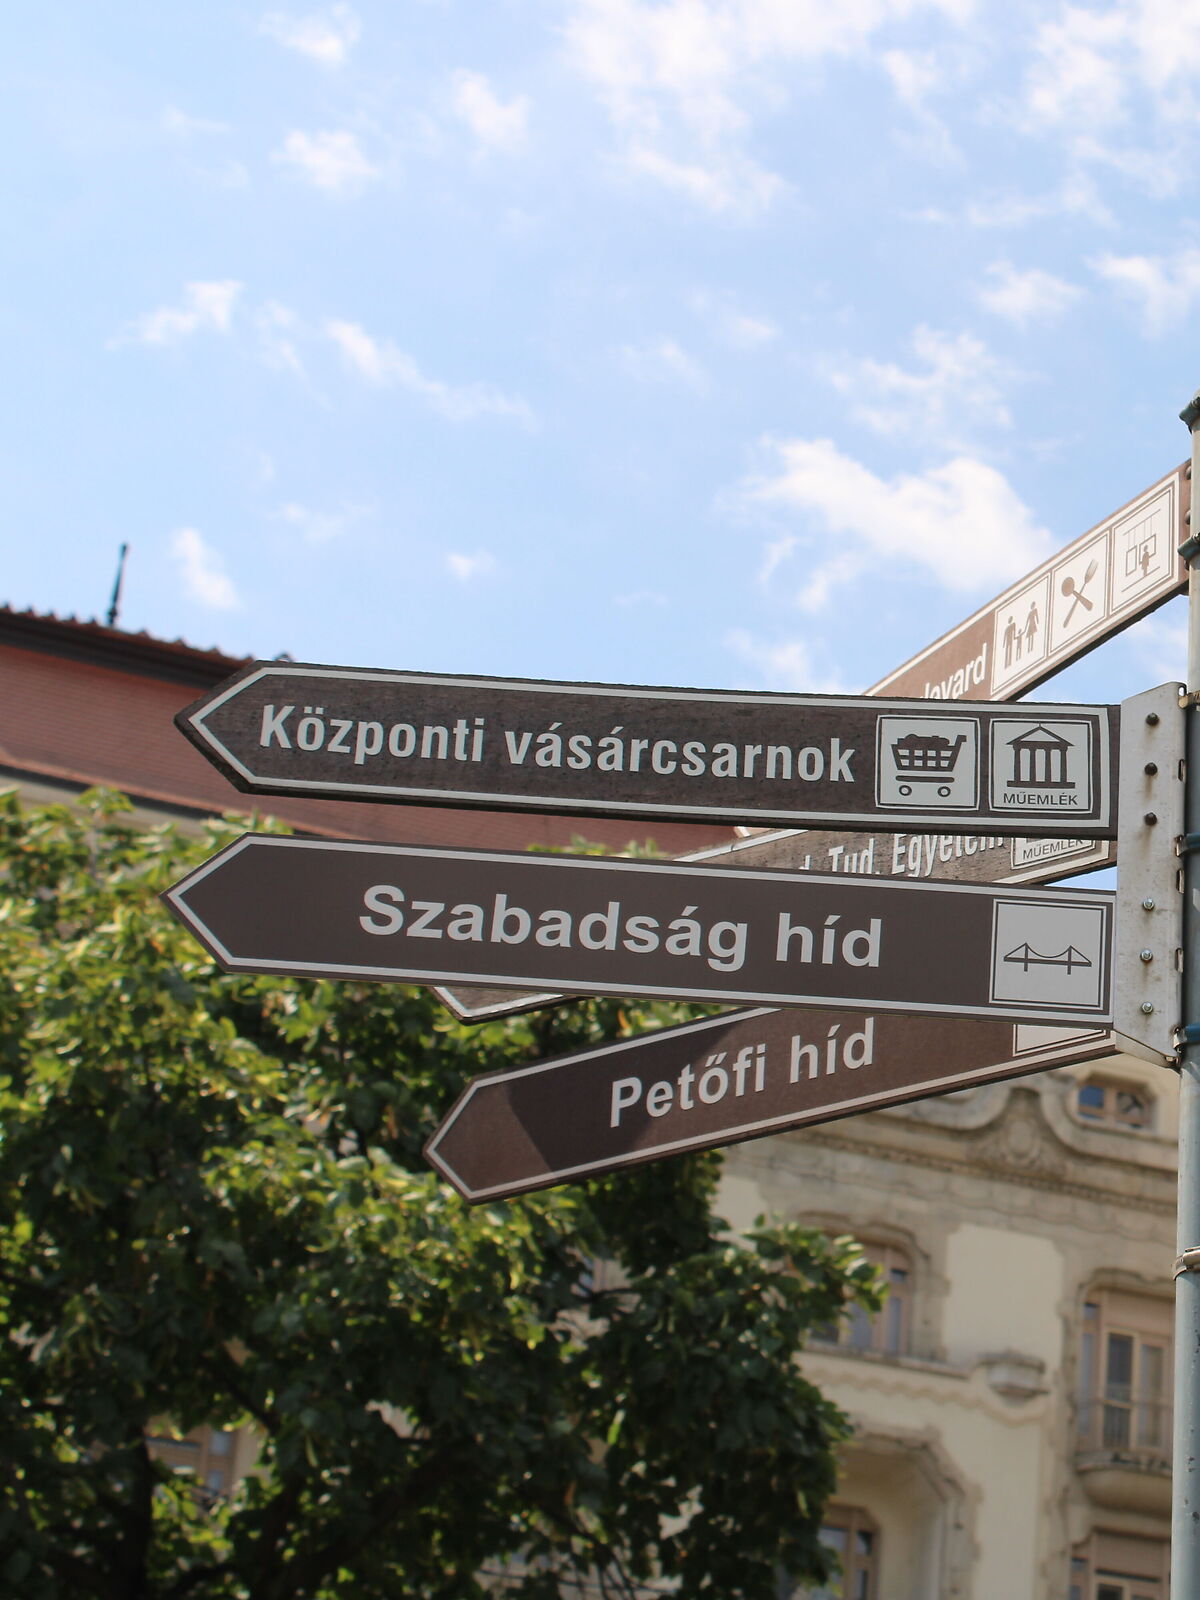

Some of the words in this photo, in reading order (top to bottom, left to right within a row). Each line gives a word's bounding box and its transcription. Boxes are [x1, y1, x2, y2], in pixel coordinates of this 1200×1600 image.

[259, 704, 485, 765] Központi
[504, 722, 856, 784] vásárcsarnok
[1003, 791, 1078, 806] MŰEMLÉK
[359, 884, 748, 972] Szabadság
[775, 912, 882, 968] híd
[610, 1042, 766, 1128] Petőfi
[789, 1016, 875, 1084] híd
